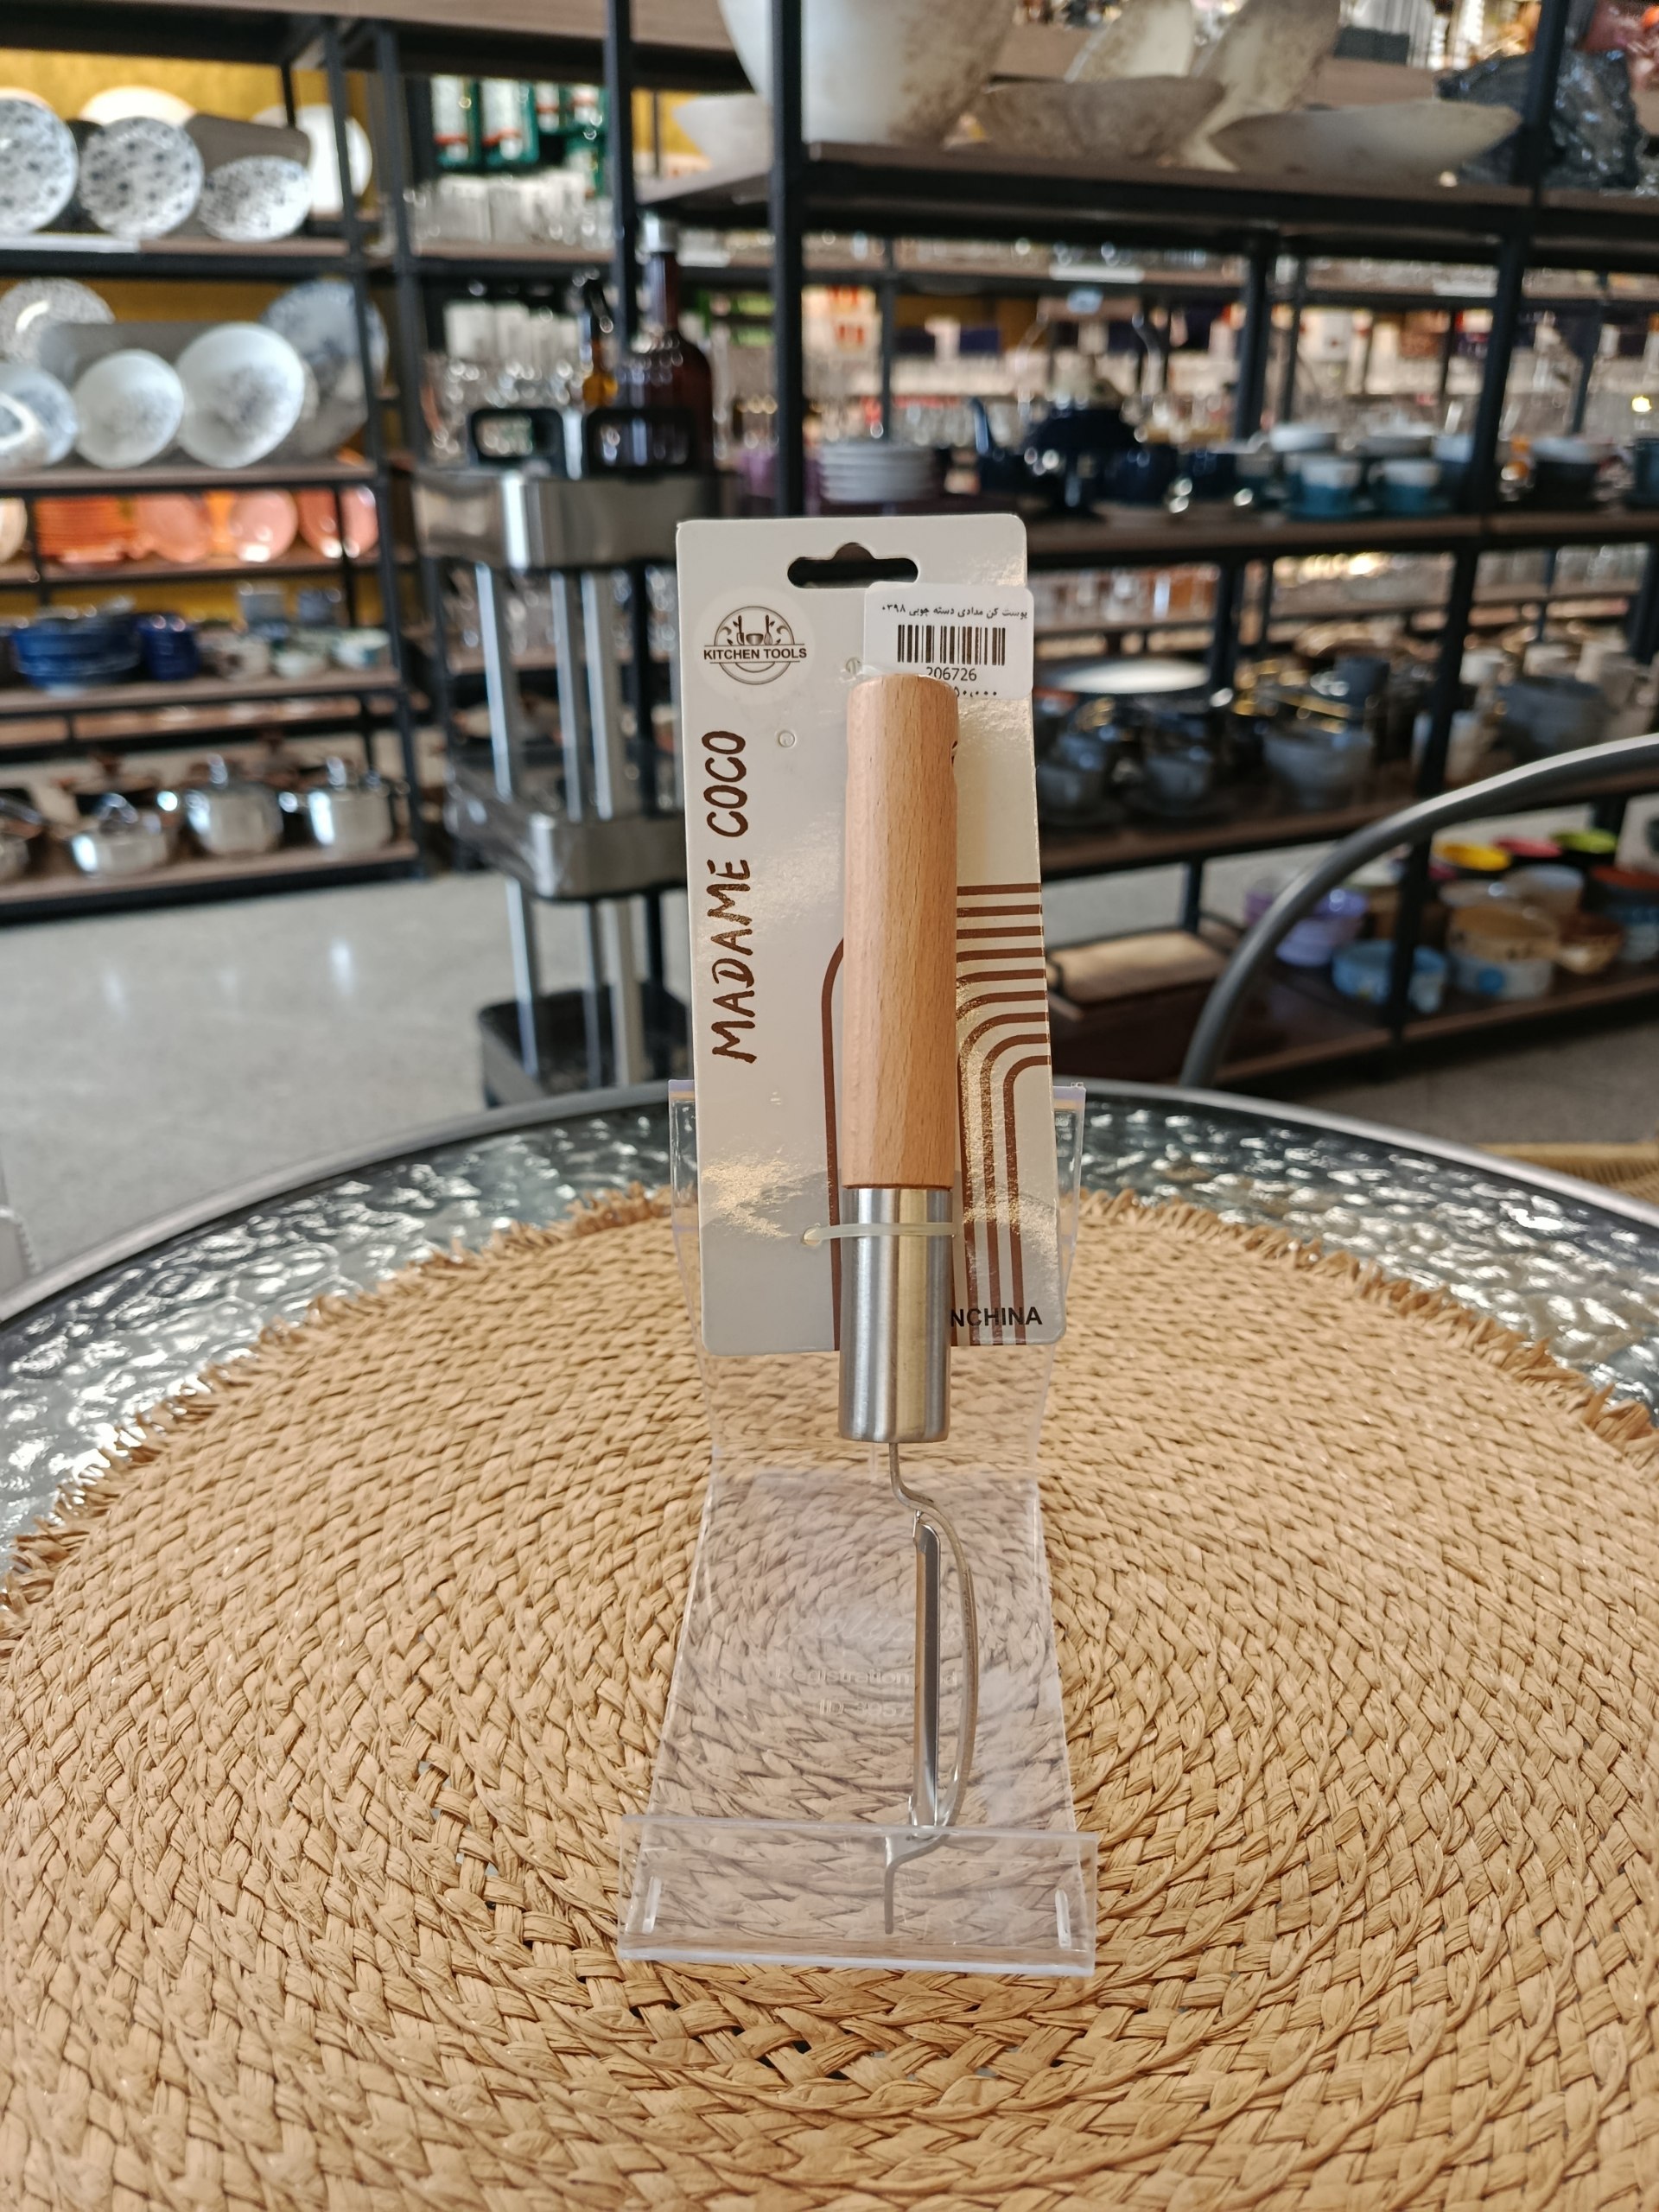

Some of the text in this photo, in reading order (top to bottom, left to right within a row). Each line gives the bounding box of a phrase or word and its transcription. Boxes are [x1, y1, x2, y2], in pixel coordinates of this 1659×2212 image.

[933, 607, 955, 615] دسته
[957, 607, 983, 618] مدادی
[986, 607, 999, 619] کن
[703, 648, 807, 660] KITCHEN TOOLS
[926, 666, 977, 681] 206726
[702, 730, 757, 1064] MADAME COCO
